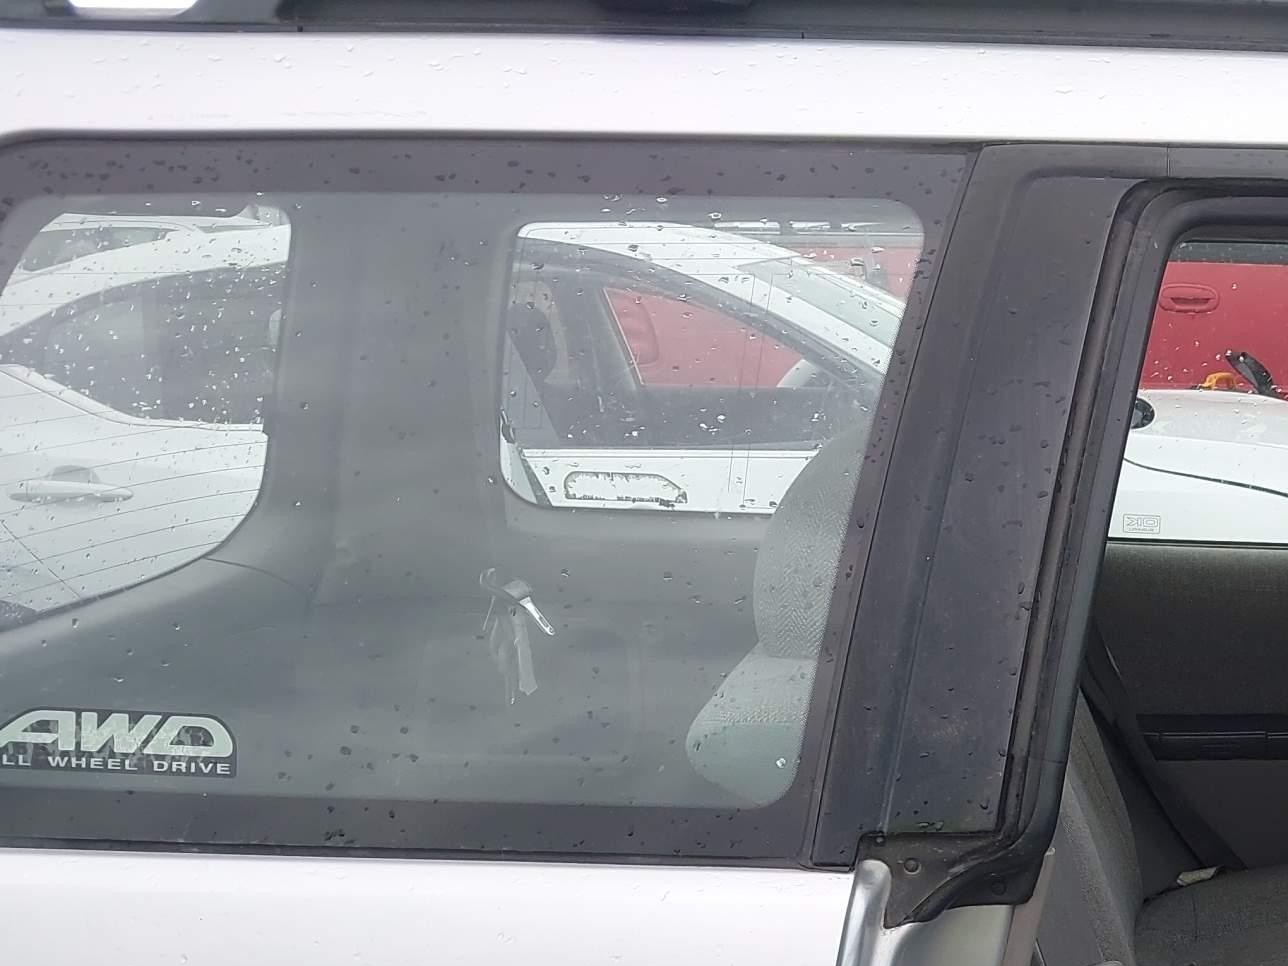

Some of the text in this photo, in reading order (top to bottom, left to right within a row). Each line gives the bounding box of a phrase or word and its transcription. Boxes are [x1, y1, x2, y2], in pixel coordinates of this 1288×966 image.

[0, 709, 234, 758] AWD
[2, 754, 232, 776] LL WHEEL DRIVE
